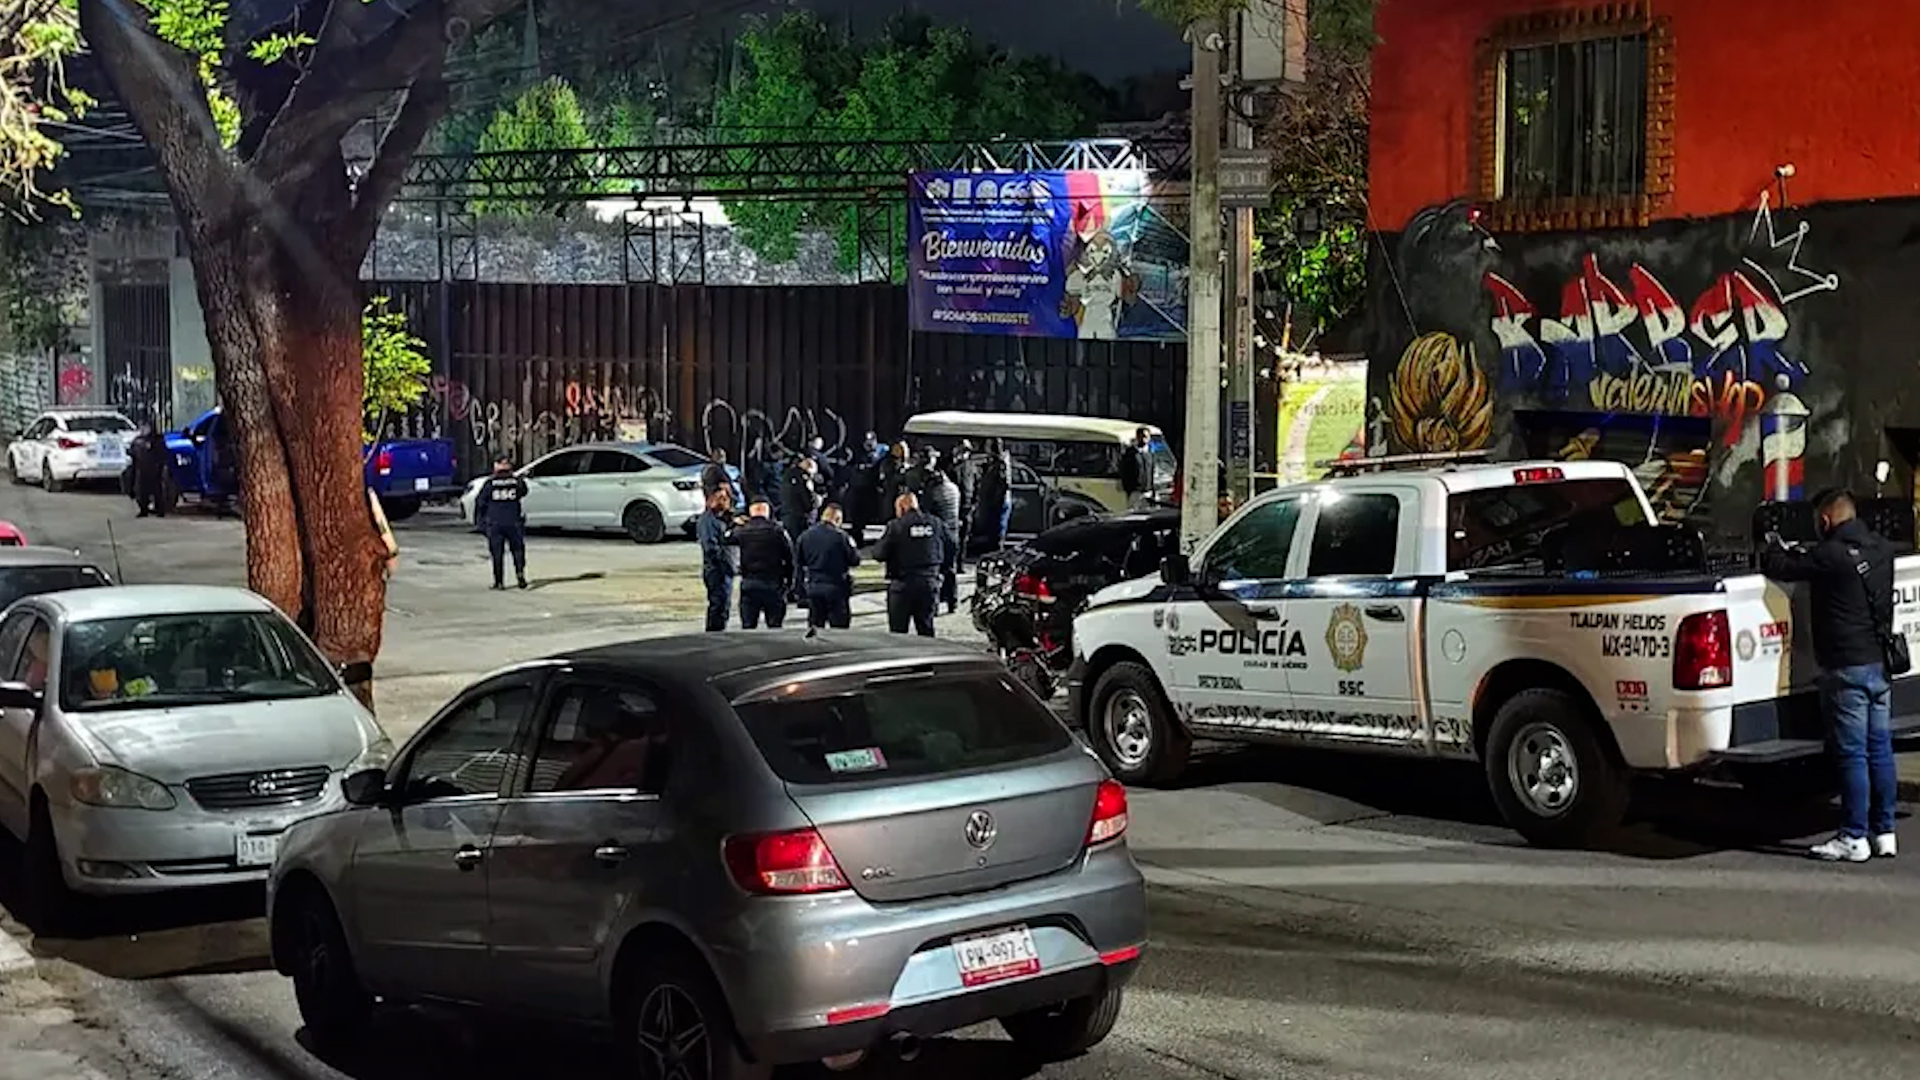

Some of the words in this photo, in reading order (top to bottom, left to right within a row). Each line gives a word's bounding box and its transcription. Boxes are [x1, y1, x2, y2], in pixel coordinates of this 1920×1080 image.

[921, 230, 1046, 264] Bienvenidos
[1570, 612, 1619, 628] TLALPAN
[1623, 614, 1665, 630] HELIOS
[1200, 620, 1306, 656] POLICÍA
[1338, 681, 1364, 695] SSC
